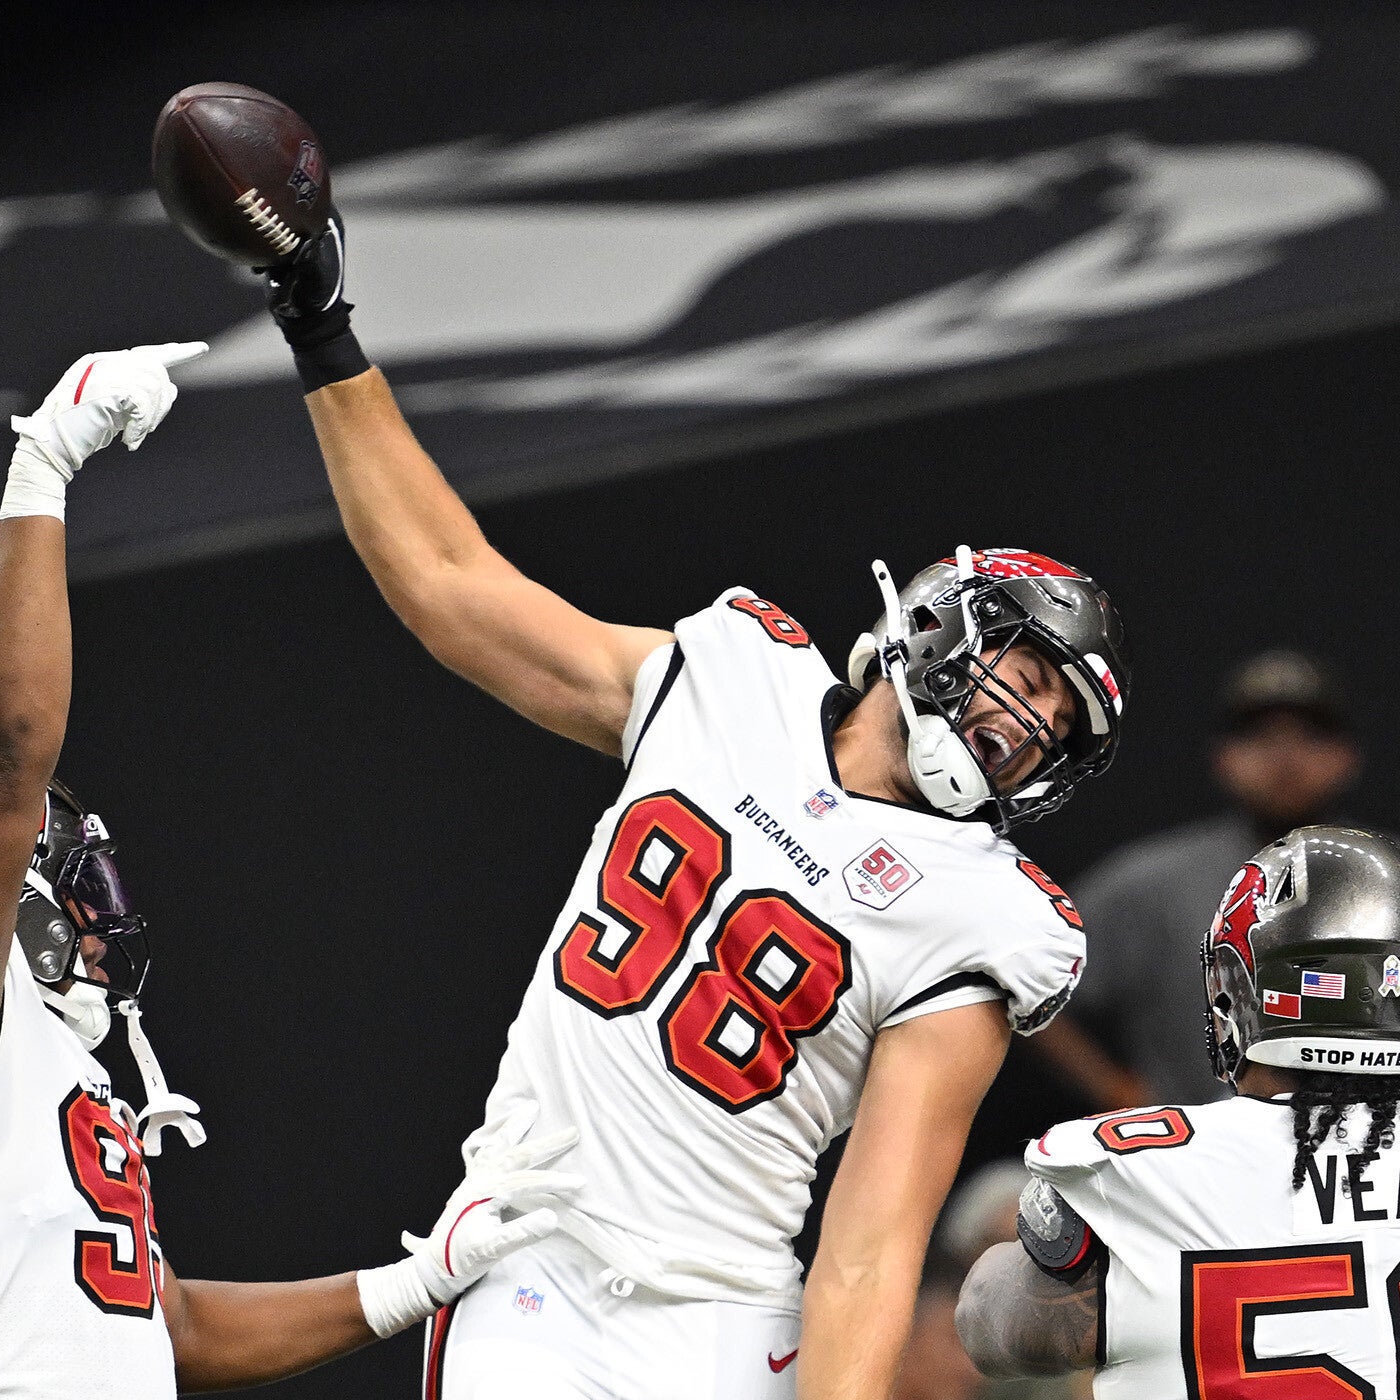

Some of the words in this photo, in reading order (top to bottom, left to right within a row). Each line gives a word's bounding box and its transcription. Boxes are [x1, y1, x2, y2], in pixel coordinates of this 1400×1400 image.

[734, 794, 831, 887] BUCCANEERS
[861, 846, 911, 893] 50
[554, 788, 853, 1115] 98
[1300, 1047, 1355, 1066] STOP
